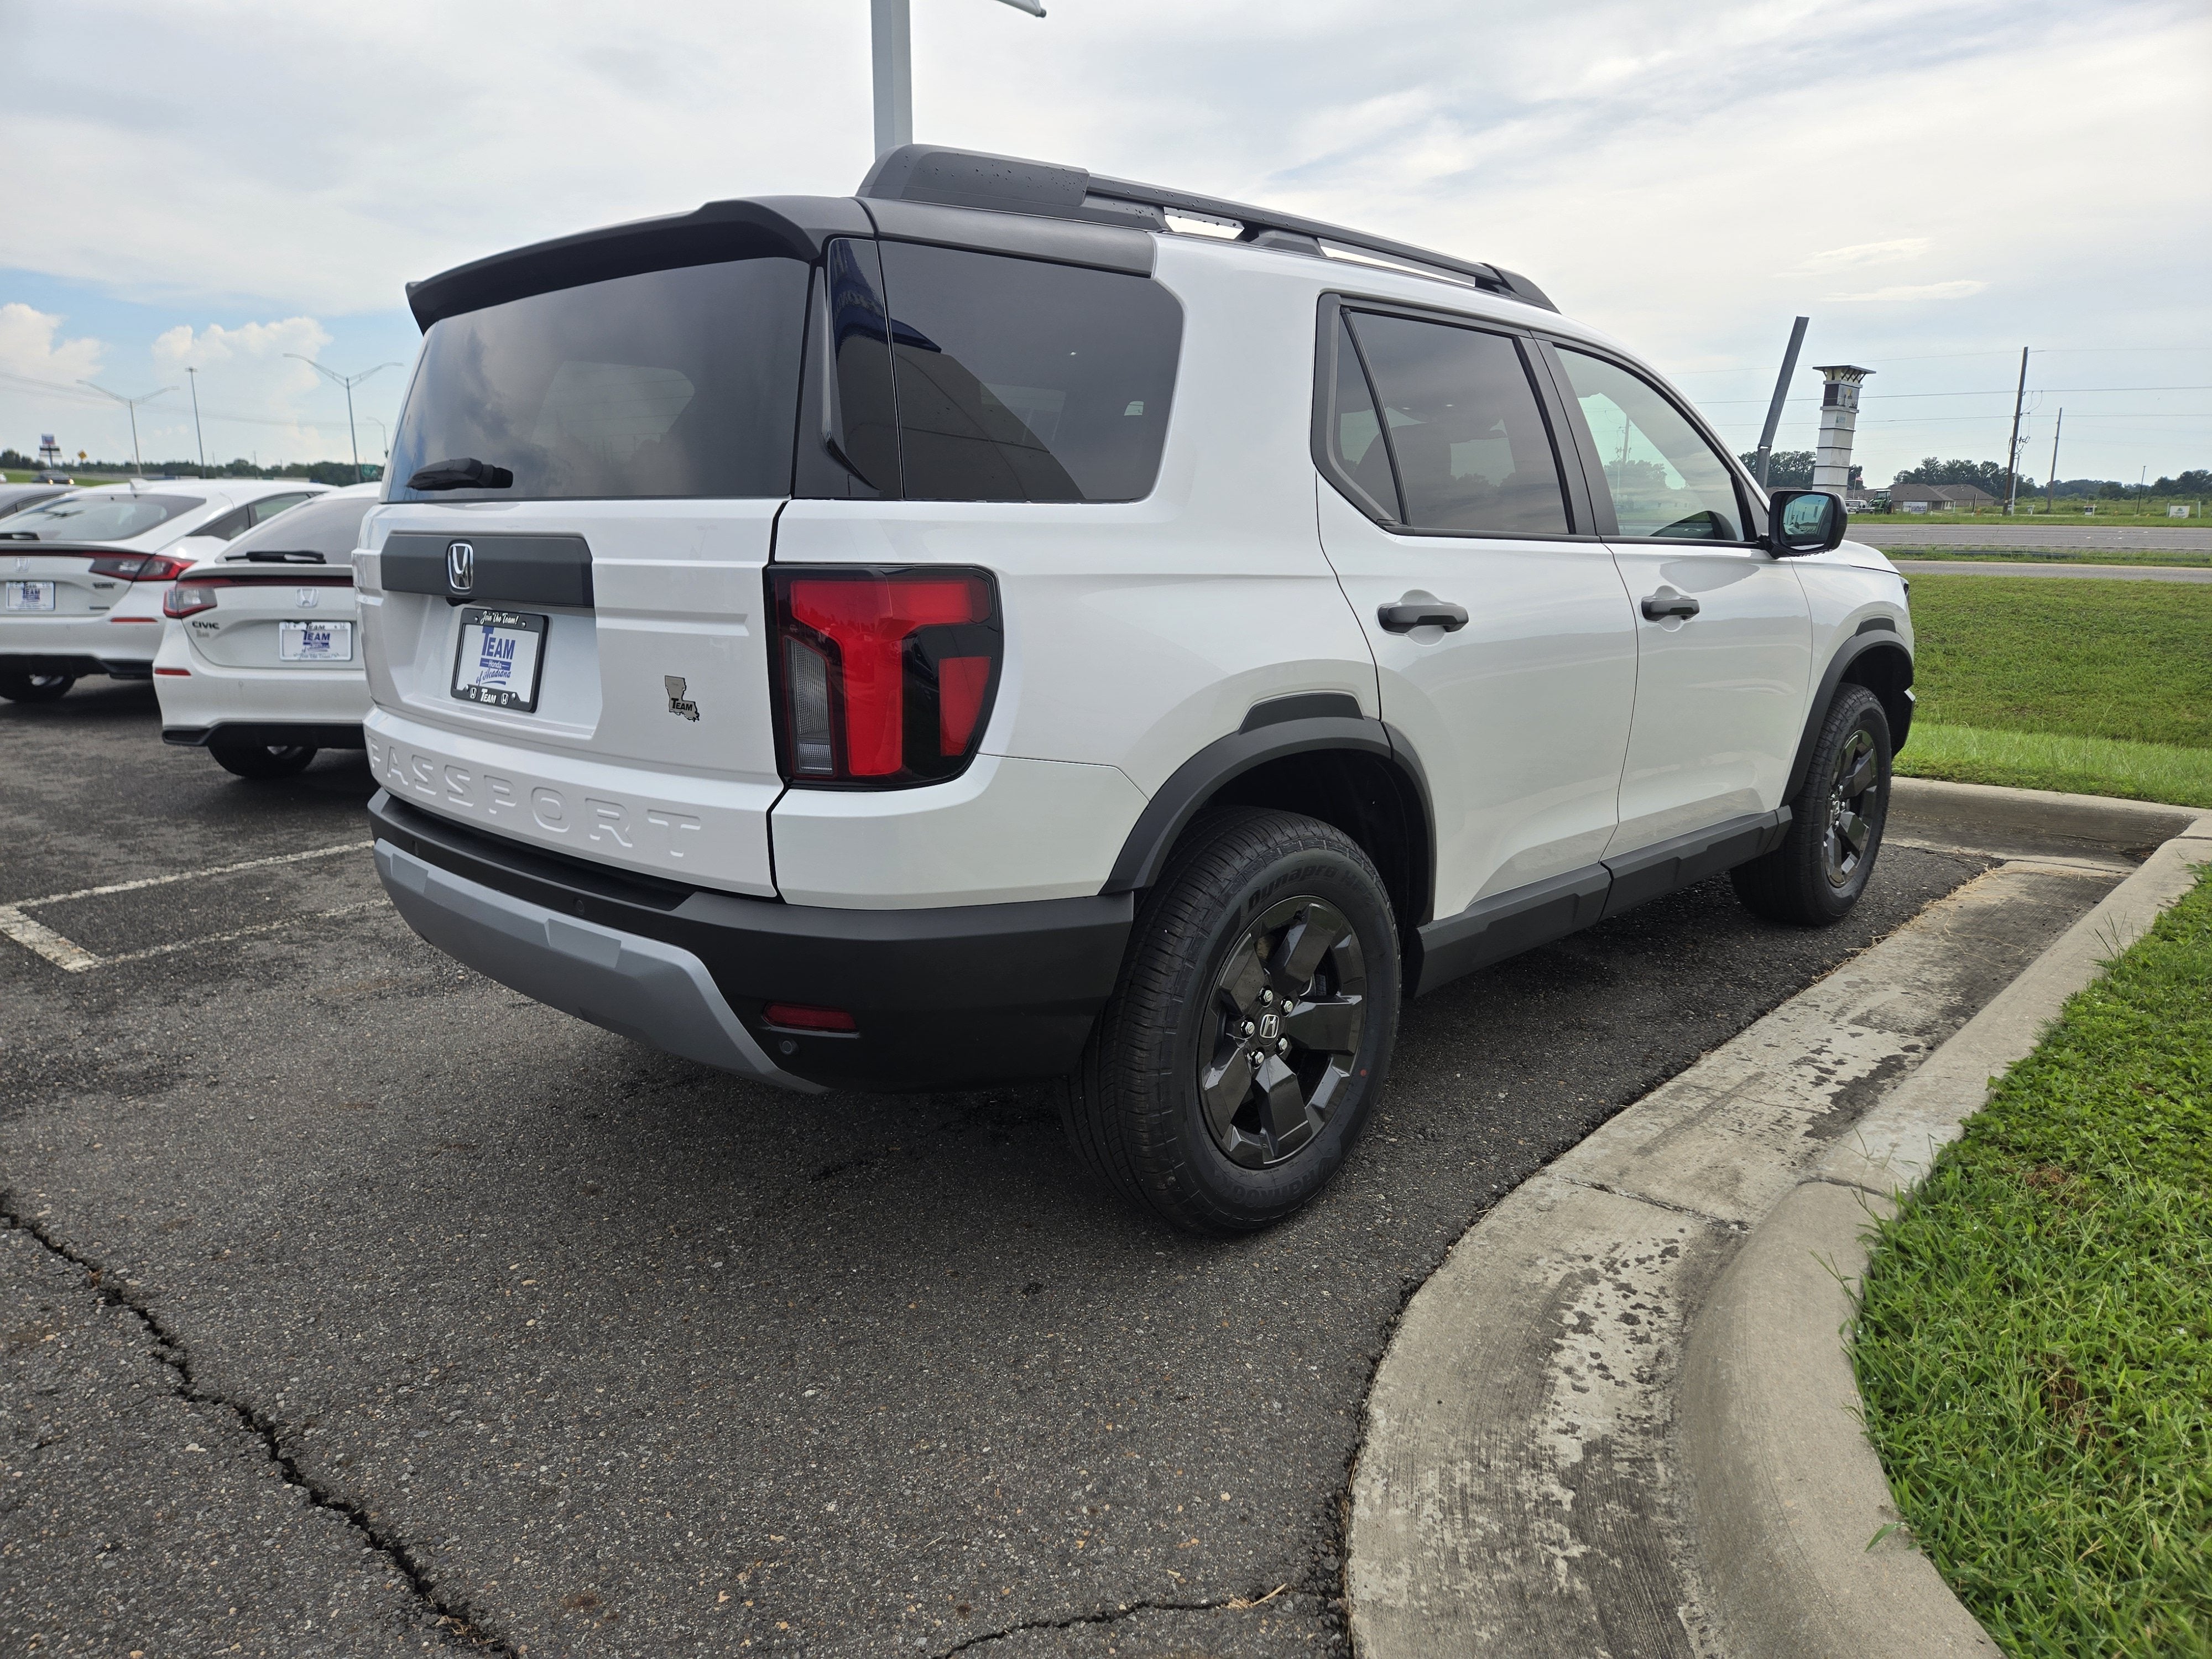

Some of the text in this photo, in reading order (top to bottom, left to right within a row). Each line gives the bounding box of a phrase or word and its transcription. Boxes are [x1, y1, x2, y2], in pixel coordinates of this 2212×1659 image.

[192, 620, 220, 630] CIVIC
[480, 611, 492, 624] Join
[502, 613, 519, 625] Team!
[301, 629, 330, 640] TEAM
[482, 625, 515, 660] TEAM
[488, 660, 502, 669] Honda
[481, 688, 497, 703] TEAM
[671, 697, 693, 711] TEAM
[367, 734, 702, 857] PASSPORT
